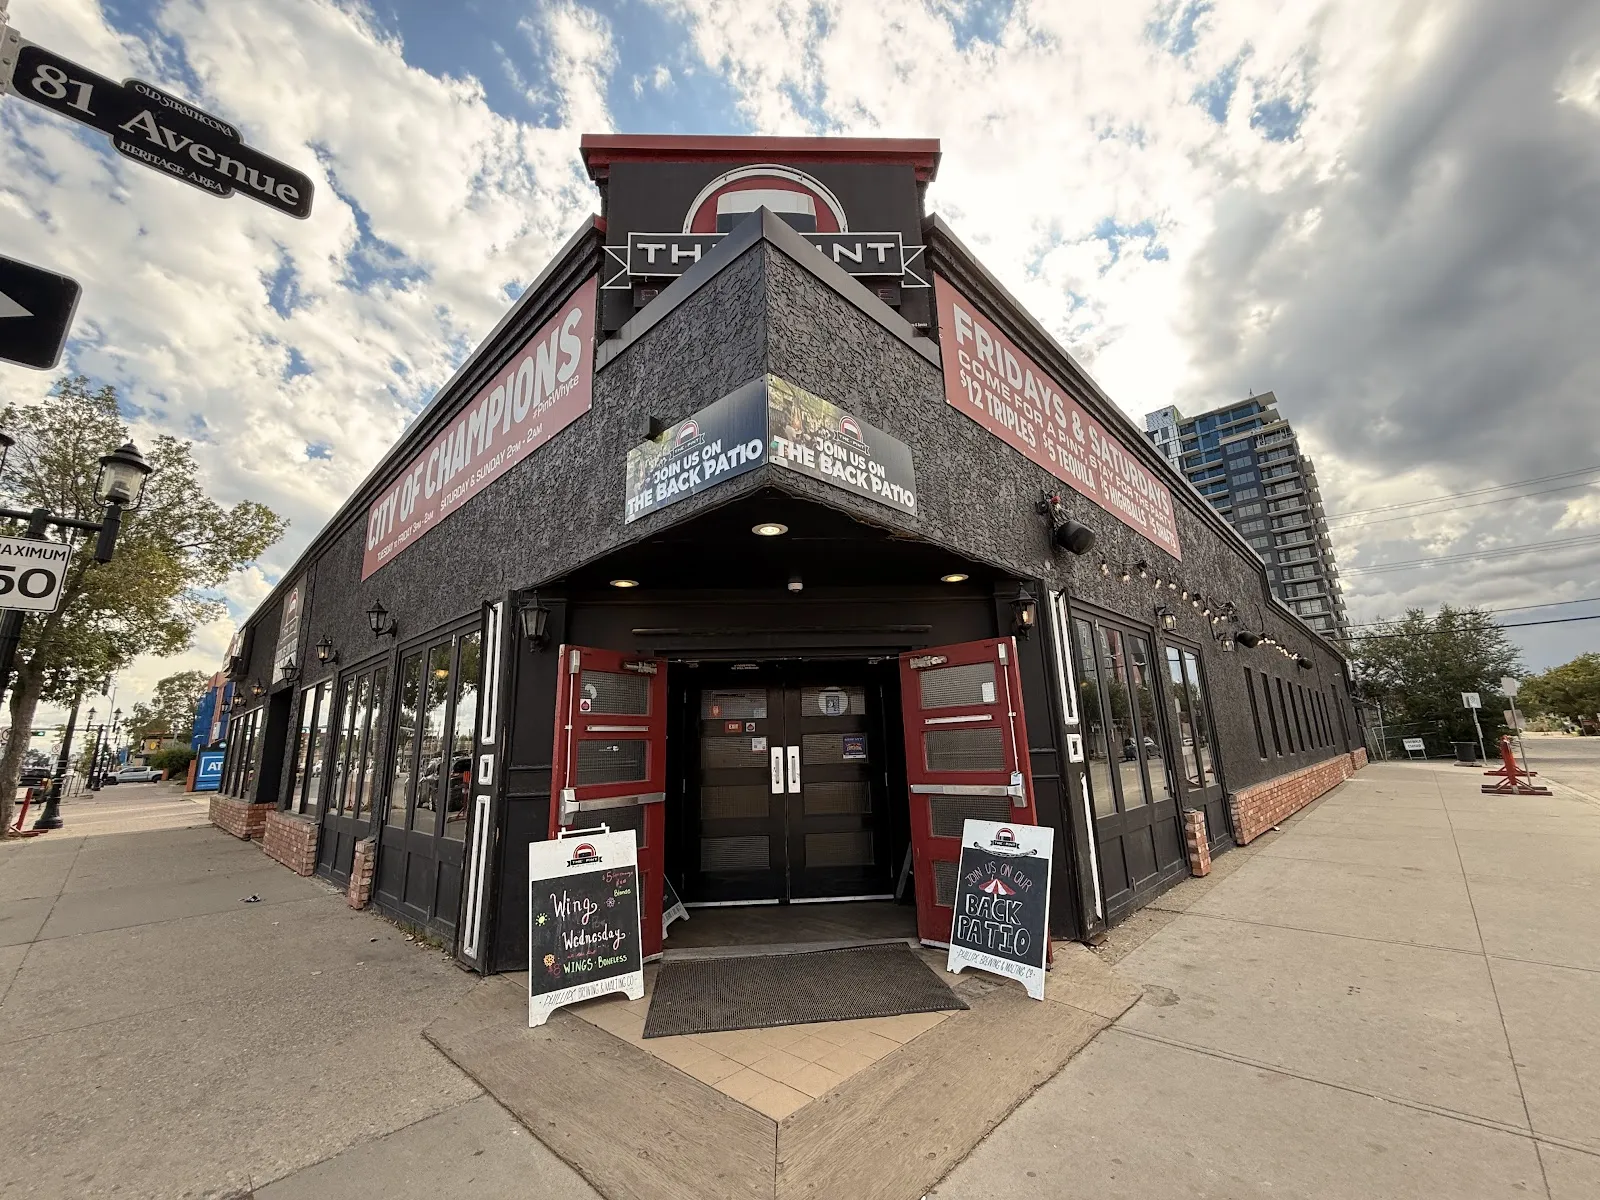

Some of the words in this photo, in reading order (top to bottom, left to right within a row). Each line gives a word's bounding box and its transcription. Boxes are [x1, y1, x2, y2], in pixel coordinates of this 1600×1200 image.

[31, 63, 96, 117] 81
[135, 84, 161, 102] OLD
[161, 97, 233, 137] STRATHCONA
[118, 109, 300, 206] Avenue
[119, 141, 185, 176] HERITAGE
[188, 171, 224, 193] AREA
[637, 243, 717, 265] TH
[816, 242, 895, 264] NT
[532, 374, 579, 419] #PintWhyte
[953, 303, 1067, 428] FRIDAYS
[1072, 411, 1085, 445] &
[1088, 425, 1169, 516] SATURDAYS
[368, 485, 400, 551] CITY
[400, 460, 425, 522] OF
[424, 307, 582, 499] CHAMPIONS
[958, 349, 1011, 403] COME
[1014, 393, 1043, 428] FOR
[1046, 421, 1056, 438] A
[1089, 455, 1113, 481] STAY
[1116, 476, 1134, 498] FOR
[1134, 492, 1149, 511] THE
[1149, 503, 1173, 530] PARTY
[960, 368, 984, 410] $12
[985, 389, 1036, 448] TRIPLES
[1043, 432, 1056, 462] $5
[1057, 444, 1096, 490] TEQUILA
[1109, 484, 1147, 528] HIGHBALLS
[440, 478, 470, 512] SATURDAY
[476, 449, 506, 482] SUNDAY
[506, 441, 522, 459] 2PM
[526, 423, 543, 443] 2AM
[627, 491, 653, 516] THE
[656, 472, 701, 501] BACK
[703, 438, 763, 481] PATIO
[653, 461, 681, 485] JOIN
[683, 451, 700, 470] US
[702, 438, 721, 461] ON
[773, 435, 816, 469] THE
[820, 452, 868, 492] BACK
[869, 475, 915, 509] PATIO
[815, 436, 847, 462] JOIN
[850, 451, 866, 470] US
[868, 460, 885, 479] ON
[0, 543, 67, 561] AXIMUM
[397, 525, 413, 546] FRIDAY
[965, 866, 983, 887] JOIN
[984, 860, 997, 875] US
[1000, 863, 1013, 878] ON
[1013, 870, 1033, 893] OUR
[549, 890, 598, 926] Wing
[965, 893, 1023, 926] BACK
[561, 923, 626, 951] Wednesday
[957, 915, 1031, 957] PATIO
[563, 958, 594, 974] WINGS
